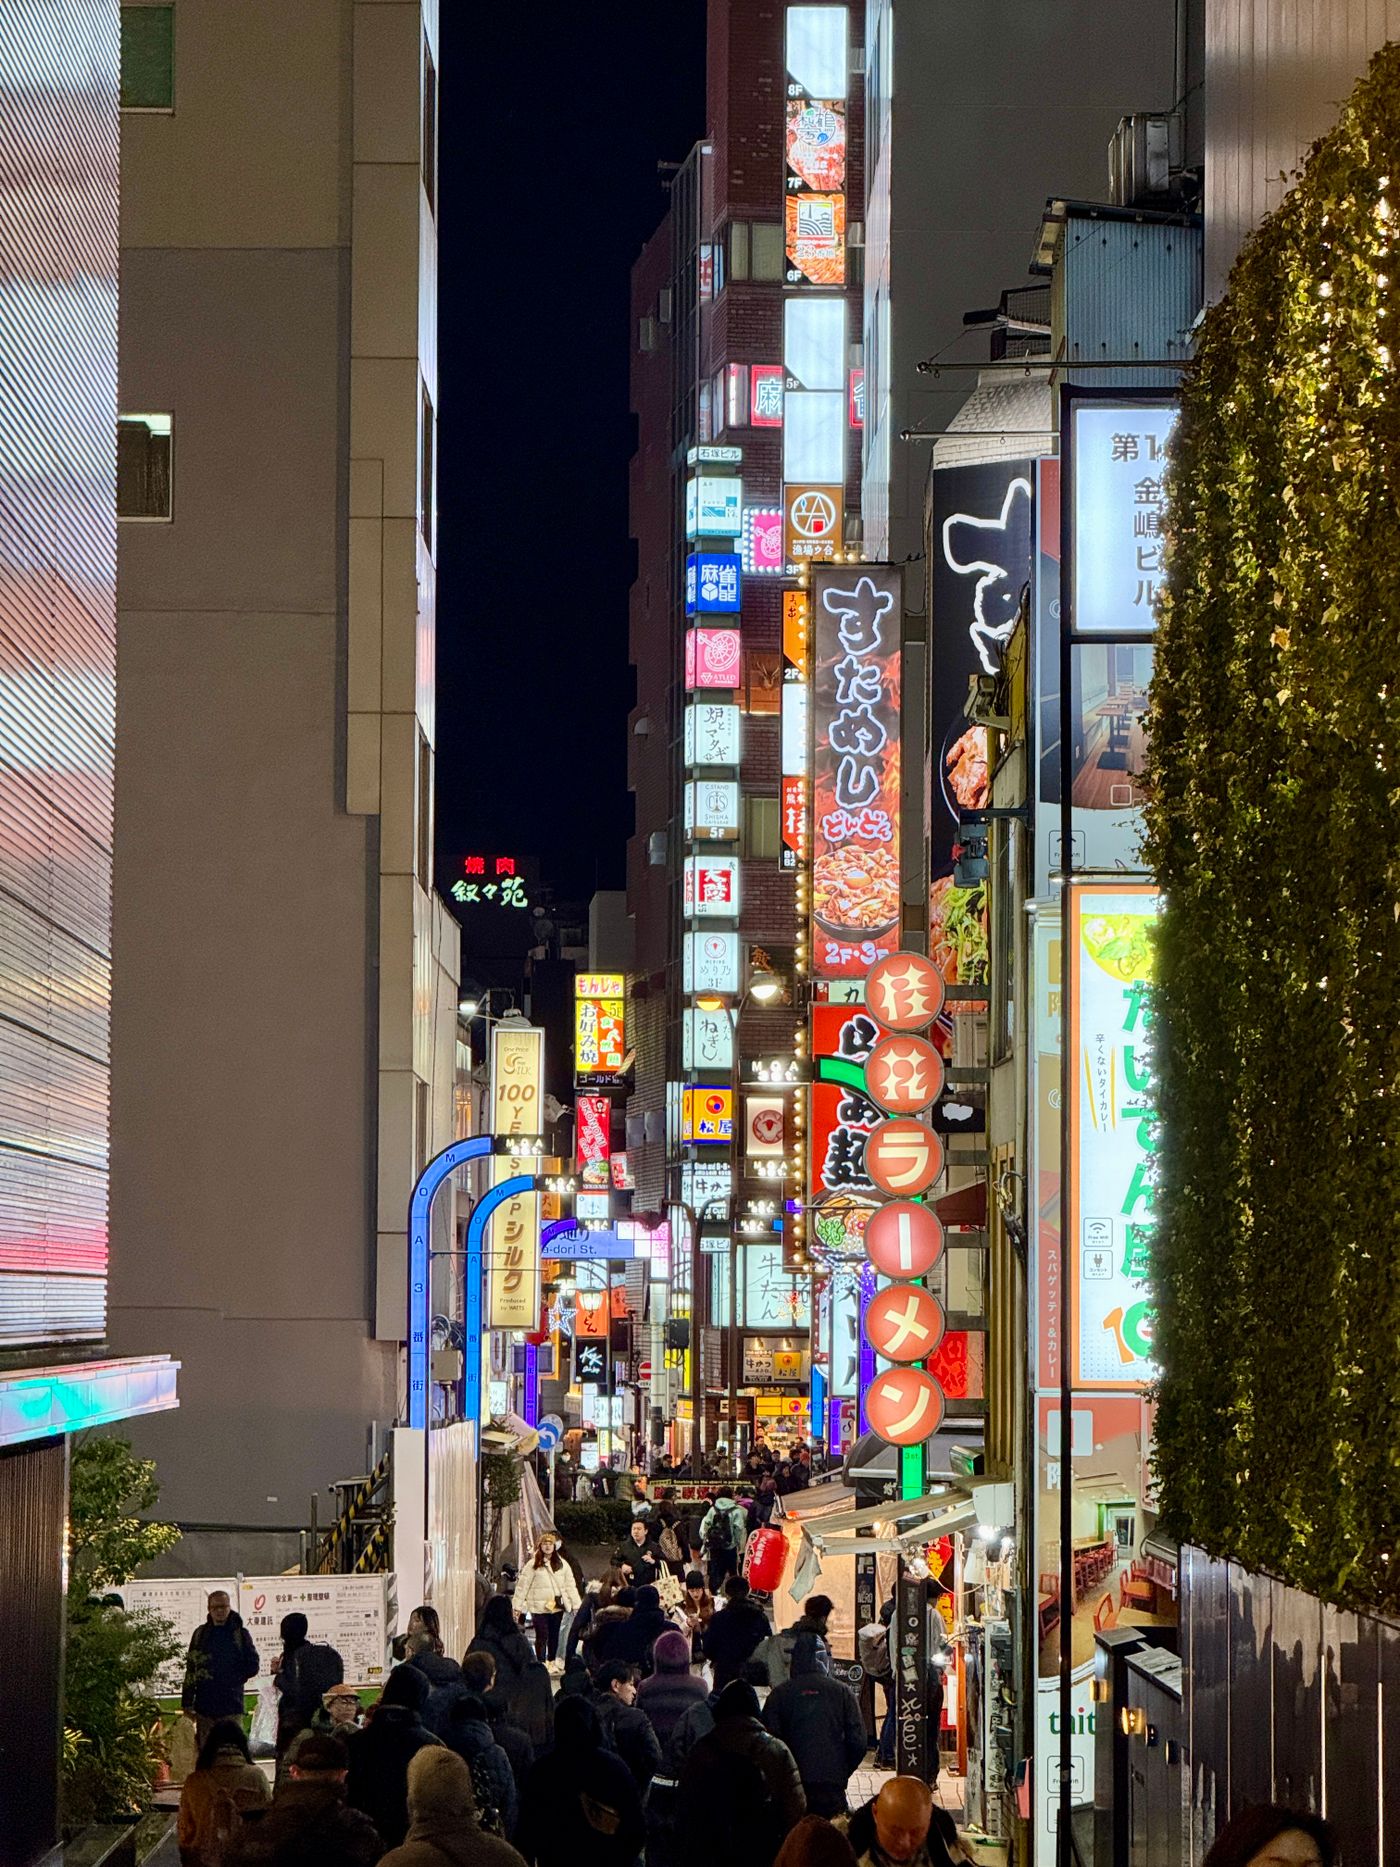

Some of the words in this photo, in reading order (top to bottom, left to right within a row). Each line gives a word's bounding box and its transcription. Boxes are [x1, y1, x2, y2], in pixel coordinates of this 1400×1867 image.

[788, 84, 803, 96] 8F
[787, 177, 802, 189] 7F
[787, 270, 802, 282] 6F
[786, 378, 800, 389] 5F
[700, 448, 739, 459] 石塚ビル
[1110, 432, 1164, 462] 第1
[701, 564, 737, 584] 麻雀
[785, 565, 800, 575] 3F
[784, 668, 799, 680] 2F
[709, 826, 725, 839] 5F
[465, 856, 515, 875] 焼肉
[578, 977, 620, 993] もんじゃ
[609, 1003, 623, 1018] 5F
[579, 1004, 597, 1064] お好み焼
[699, 1018, 719, 1062] ねぎし
[1095, 1033, 1109, 1133] 辛くないタイカレー
[498, 1084, 535, 1101] 100
[698, 1119, 732, 1134] 松屋
[503, 1220, 524, 1294] シルク
[579, 1244, 597, 1255] St.
[757, 1252, 780, 1320] 牛たん
